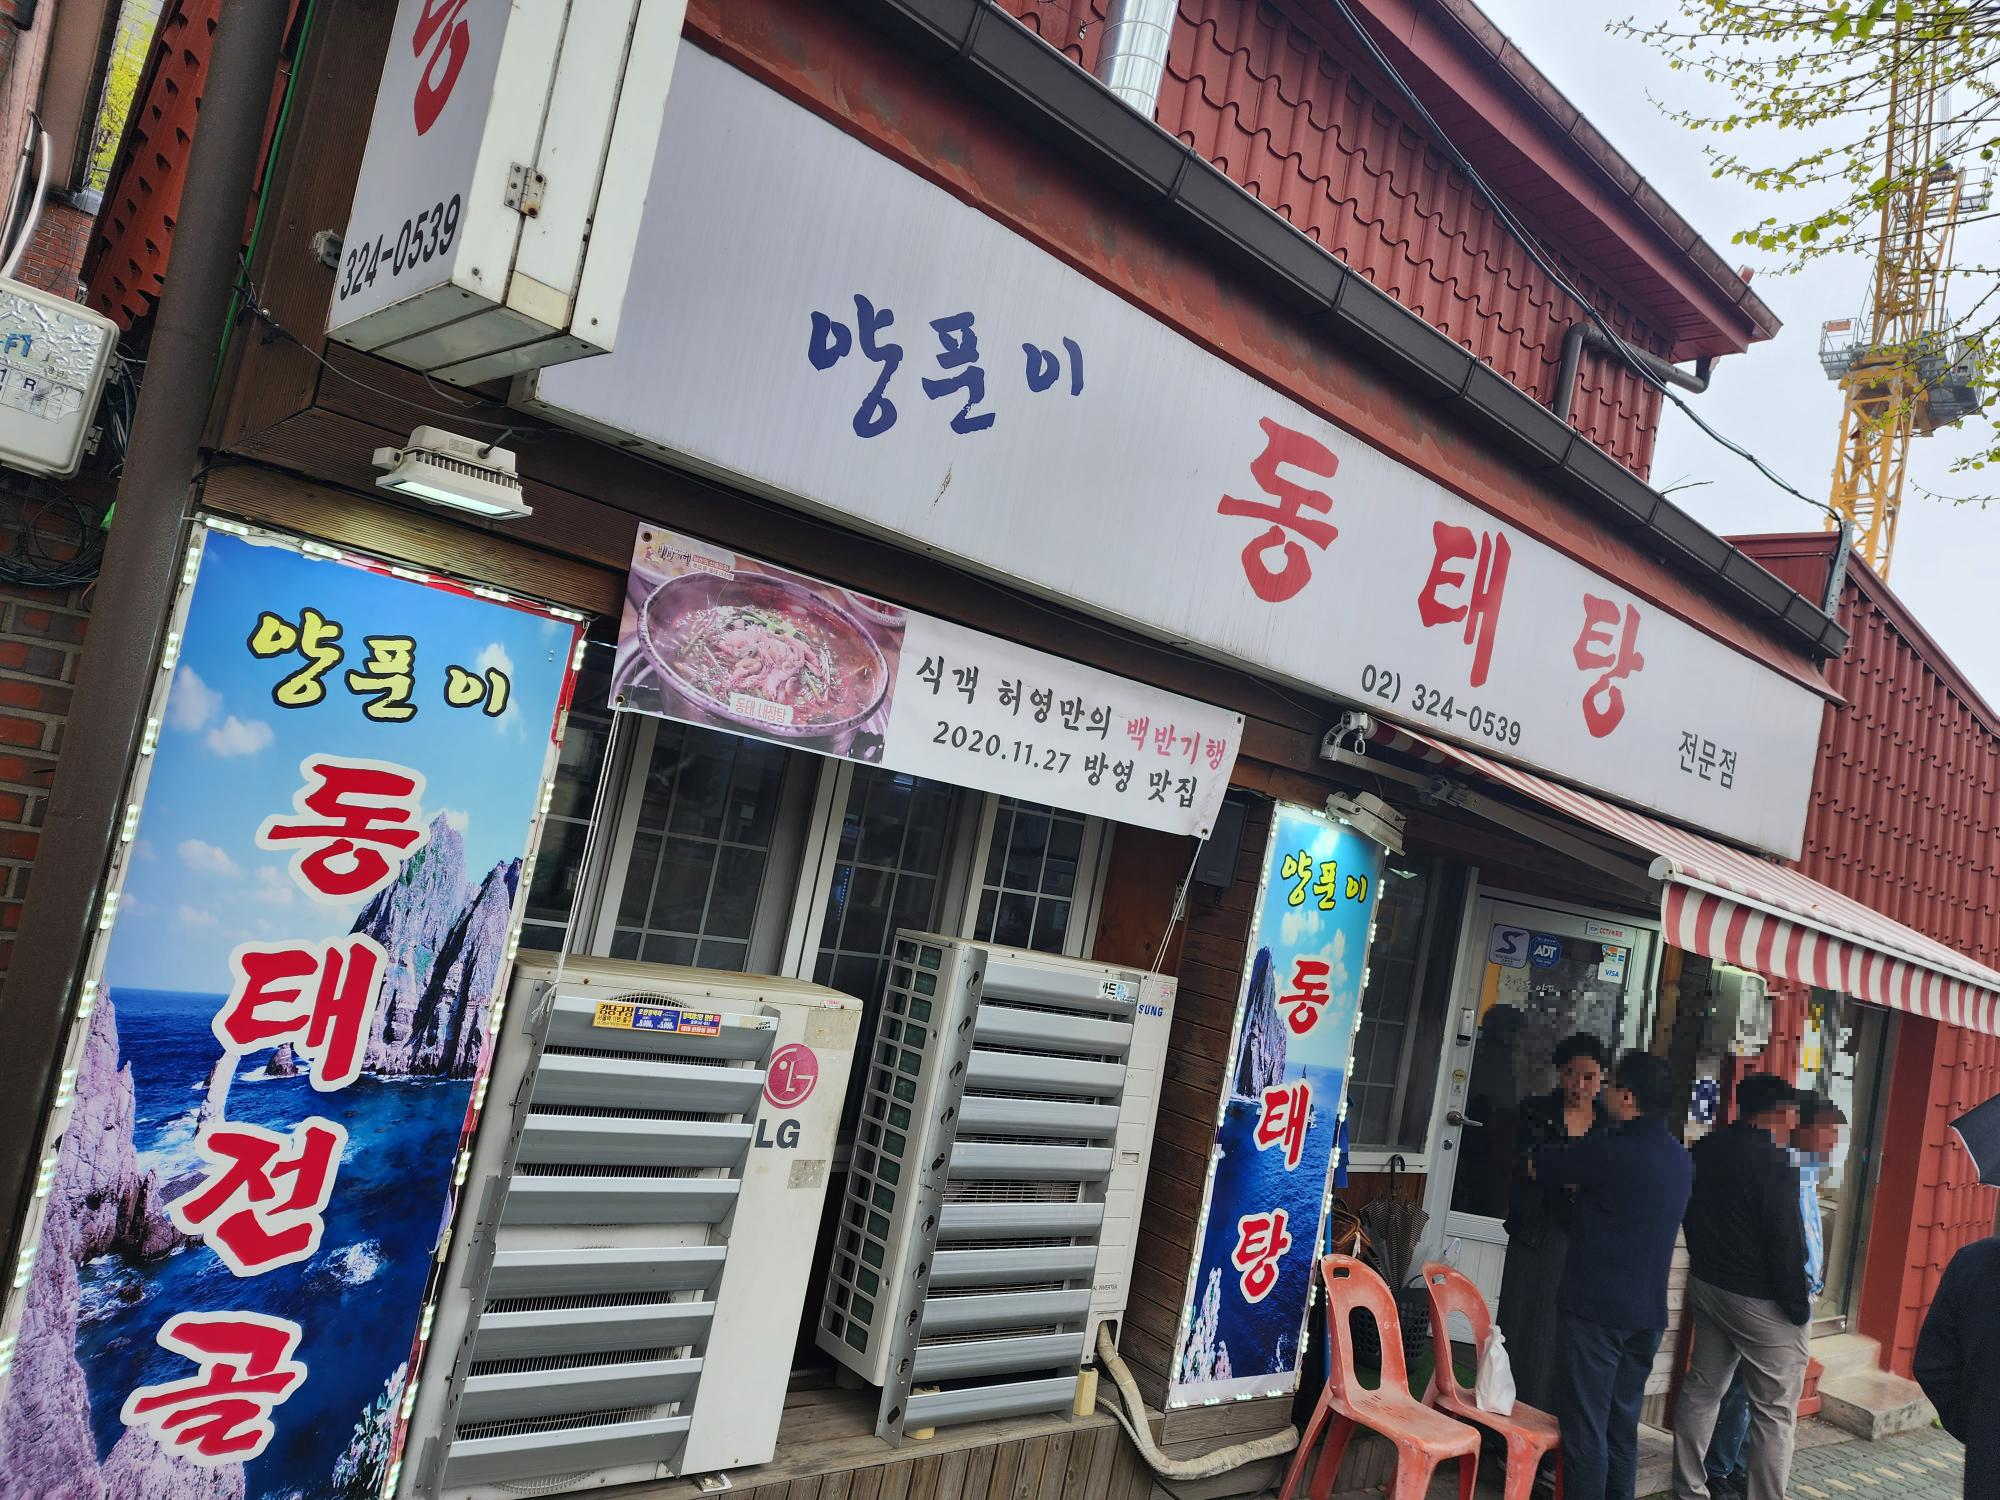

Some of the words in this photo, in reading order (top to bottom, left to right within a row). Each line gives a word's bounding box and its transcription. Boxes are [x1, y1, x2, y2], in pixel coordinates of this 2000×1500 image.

[340, 193, 461, 300] 324-0539
[808, 293, 1084, 438] 양푼이
[1678, 730, 1737, 790] 전문점
[247, 607, 510, 722] 양푼이
[1361, 664, 1401, 703] 02)
[1412, 683, 1521, 746] 324-0539
[916, 655, 979, 704] 식객
[998, 679, 1112, 740] 허영만의
[1127, 716, 1227, 771] 백반기행
[932, 720, 1071, 774] 2020.11.27
[1084, 752, 1135, 793] 방영
[1148, 769, 1198, 808] 맛집
[1281, 850, 1368, 911] 양푼이
[1533, 945, 1557, 959] ADT
[1605, 969, 1619, 977] VISA
[600, 1004, 634, 1018] 킹당구장
[755, 1118, 801, 1149] LG
